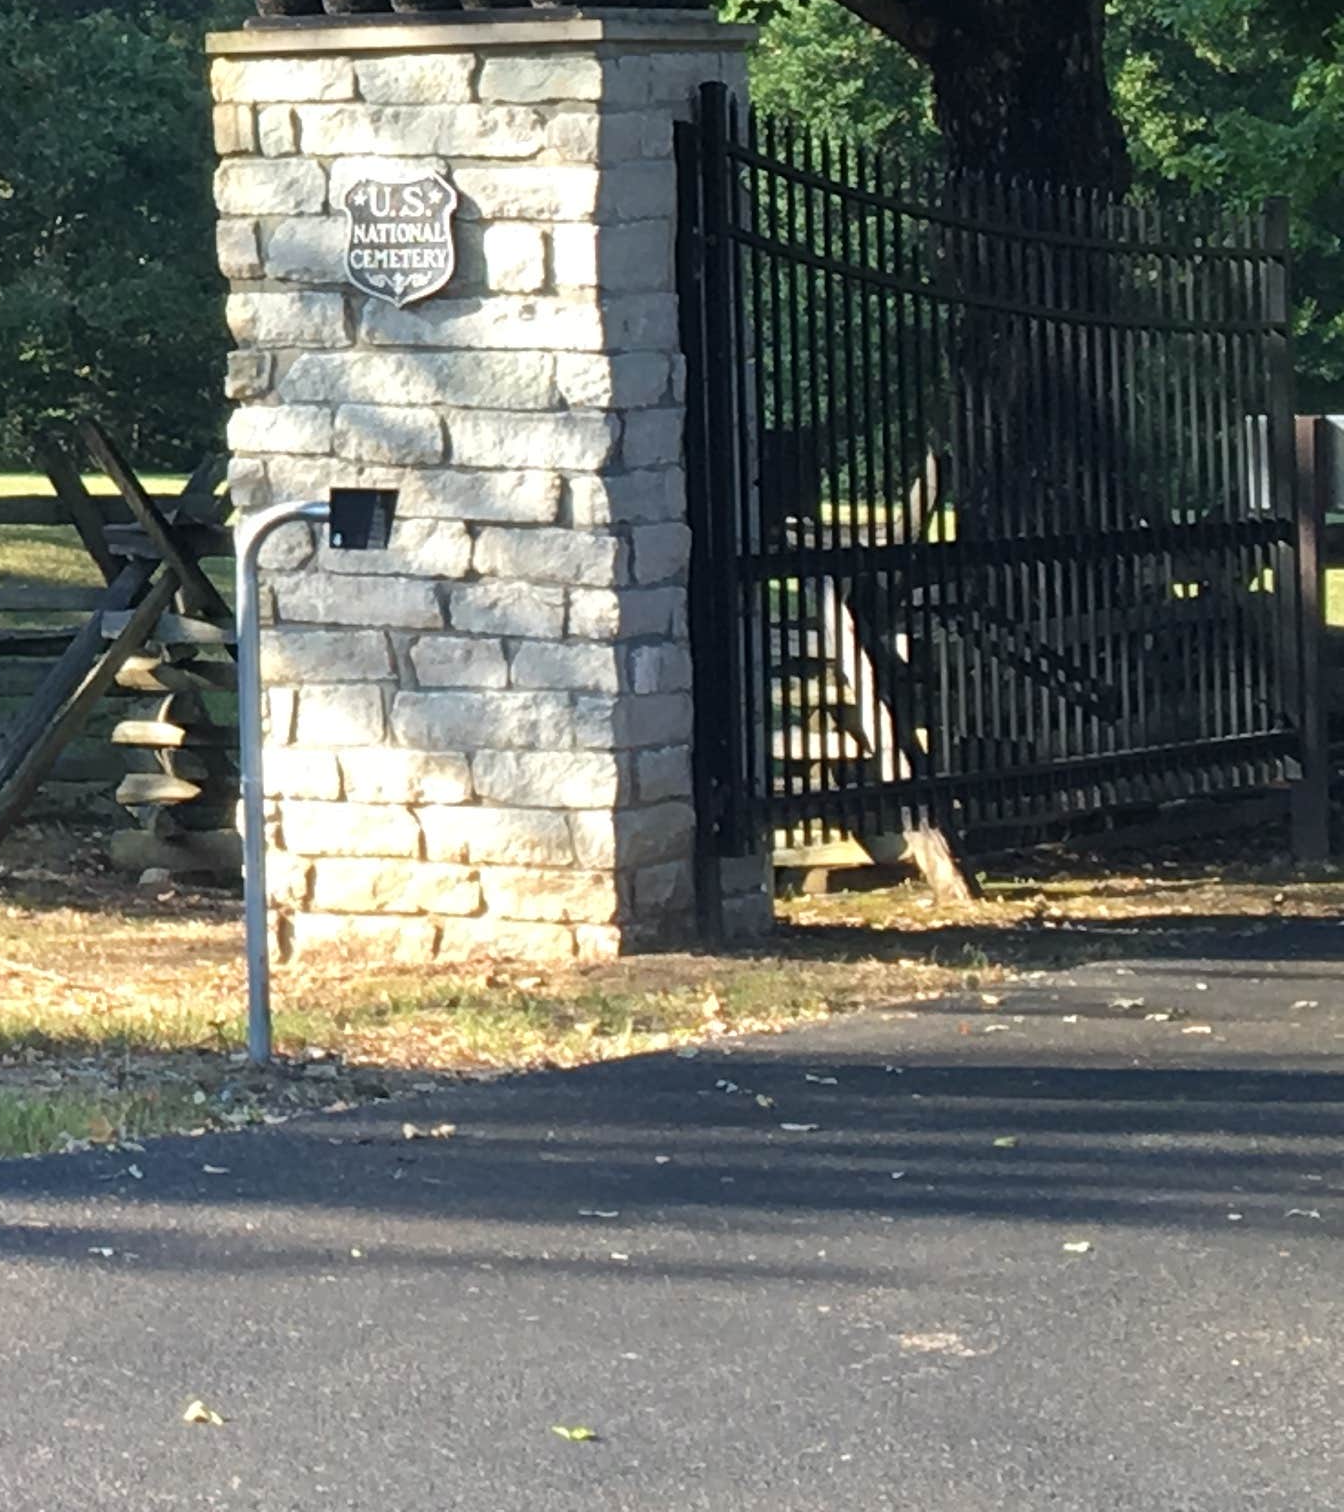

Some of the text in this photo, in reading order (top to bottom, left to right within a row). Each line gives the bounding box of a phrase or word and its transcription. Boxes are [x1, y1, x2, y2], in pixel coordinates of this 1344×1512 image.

[367, 186, 433, 218] U.S.
[353, 222, 447, 244] NATIONAL
[350, 248, 446, 270] CEMETERY
